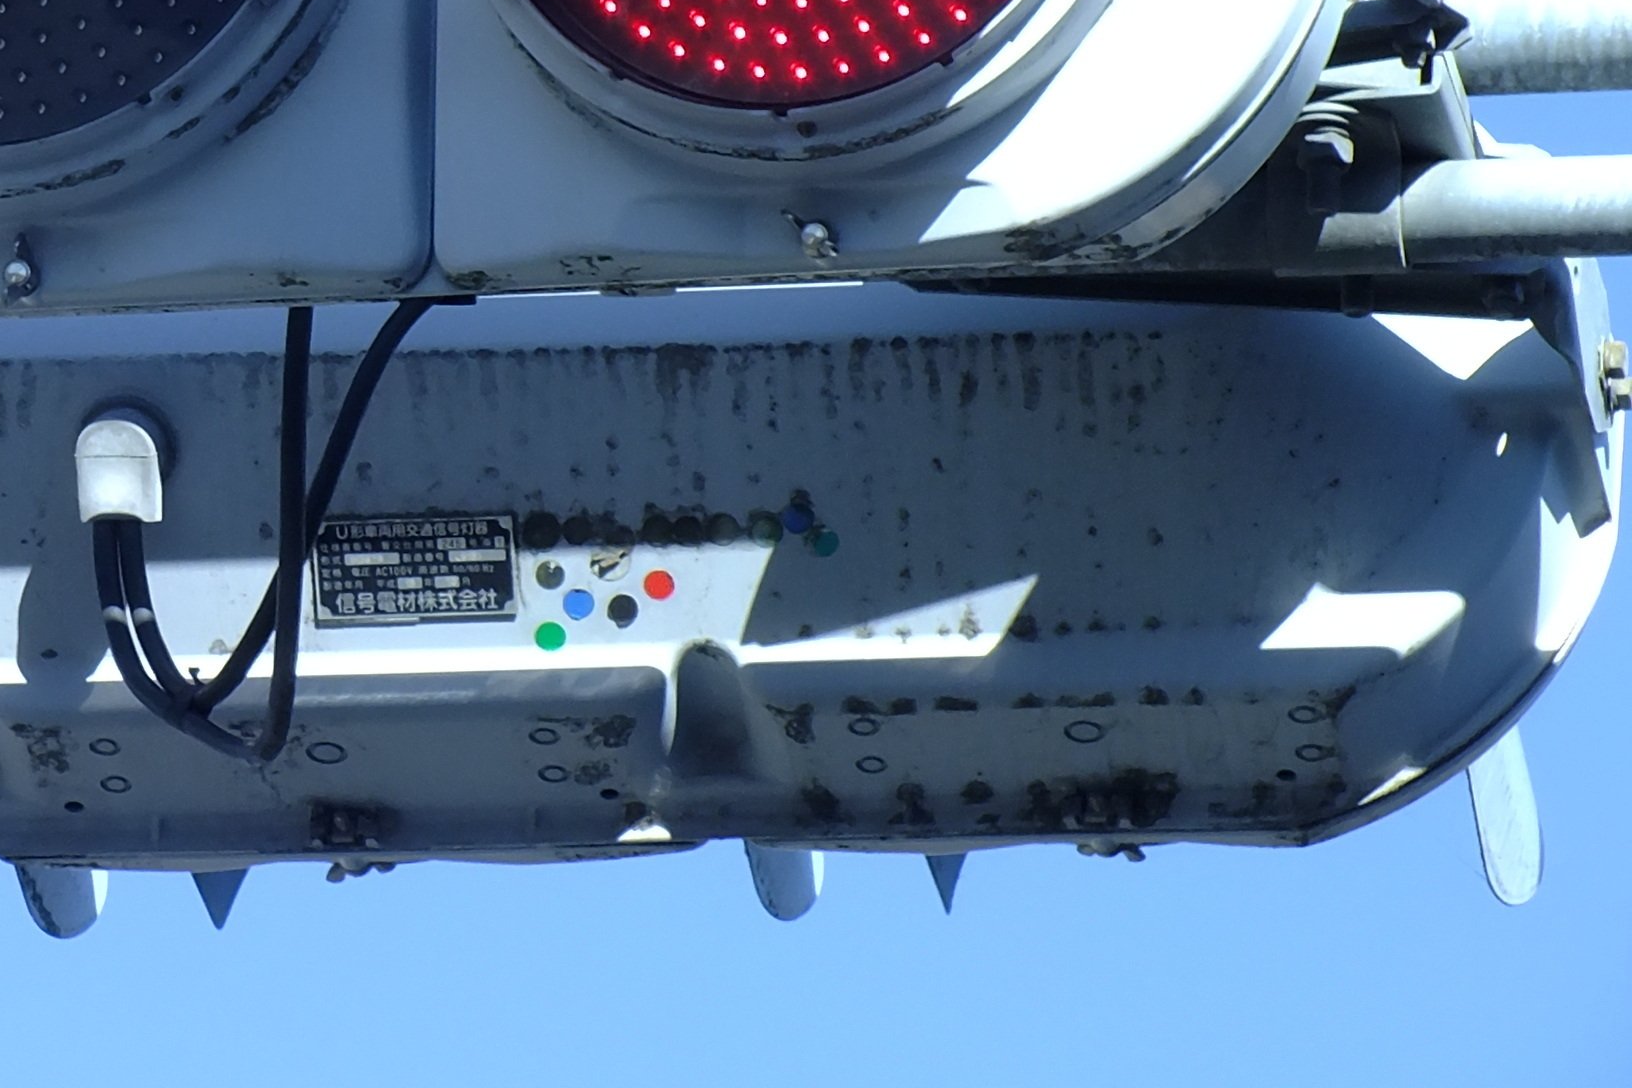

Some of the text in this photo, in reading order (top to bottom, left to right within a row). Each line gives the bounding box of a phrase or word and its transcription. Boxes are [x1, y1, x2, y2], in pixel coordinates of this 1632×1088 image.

[375, 564, 414, 577] AC100V
[335, 588, 499, 614] 信号電材株式会社
